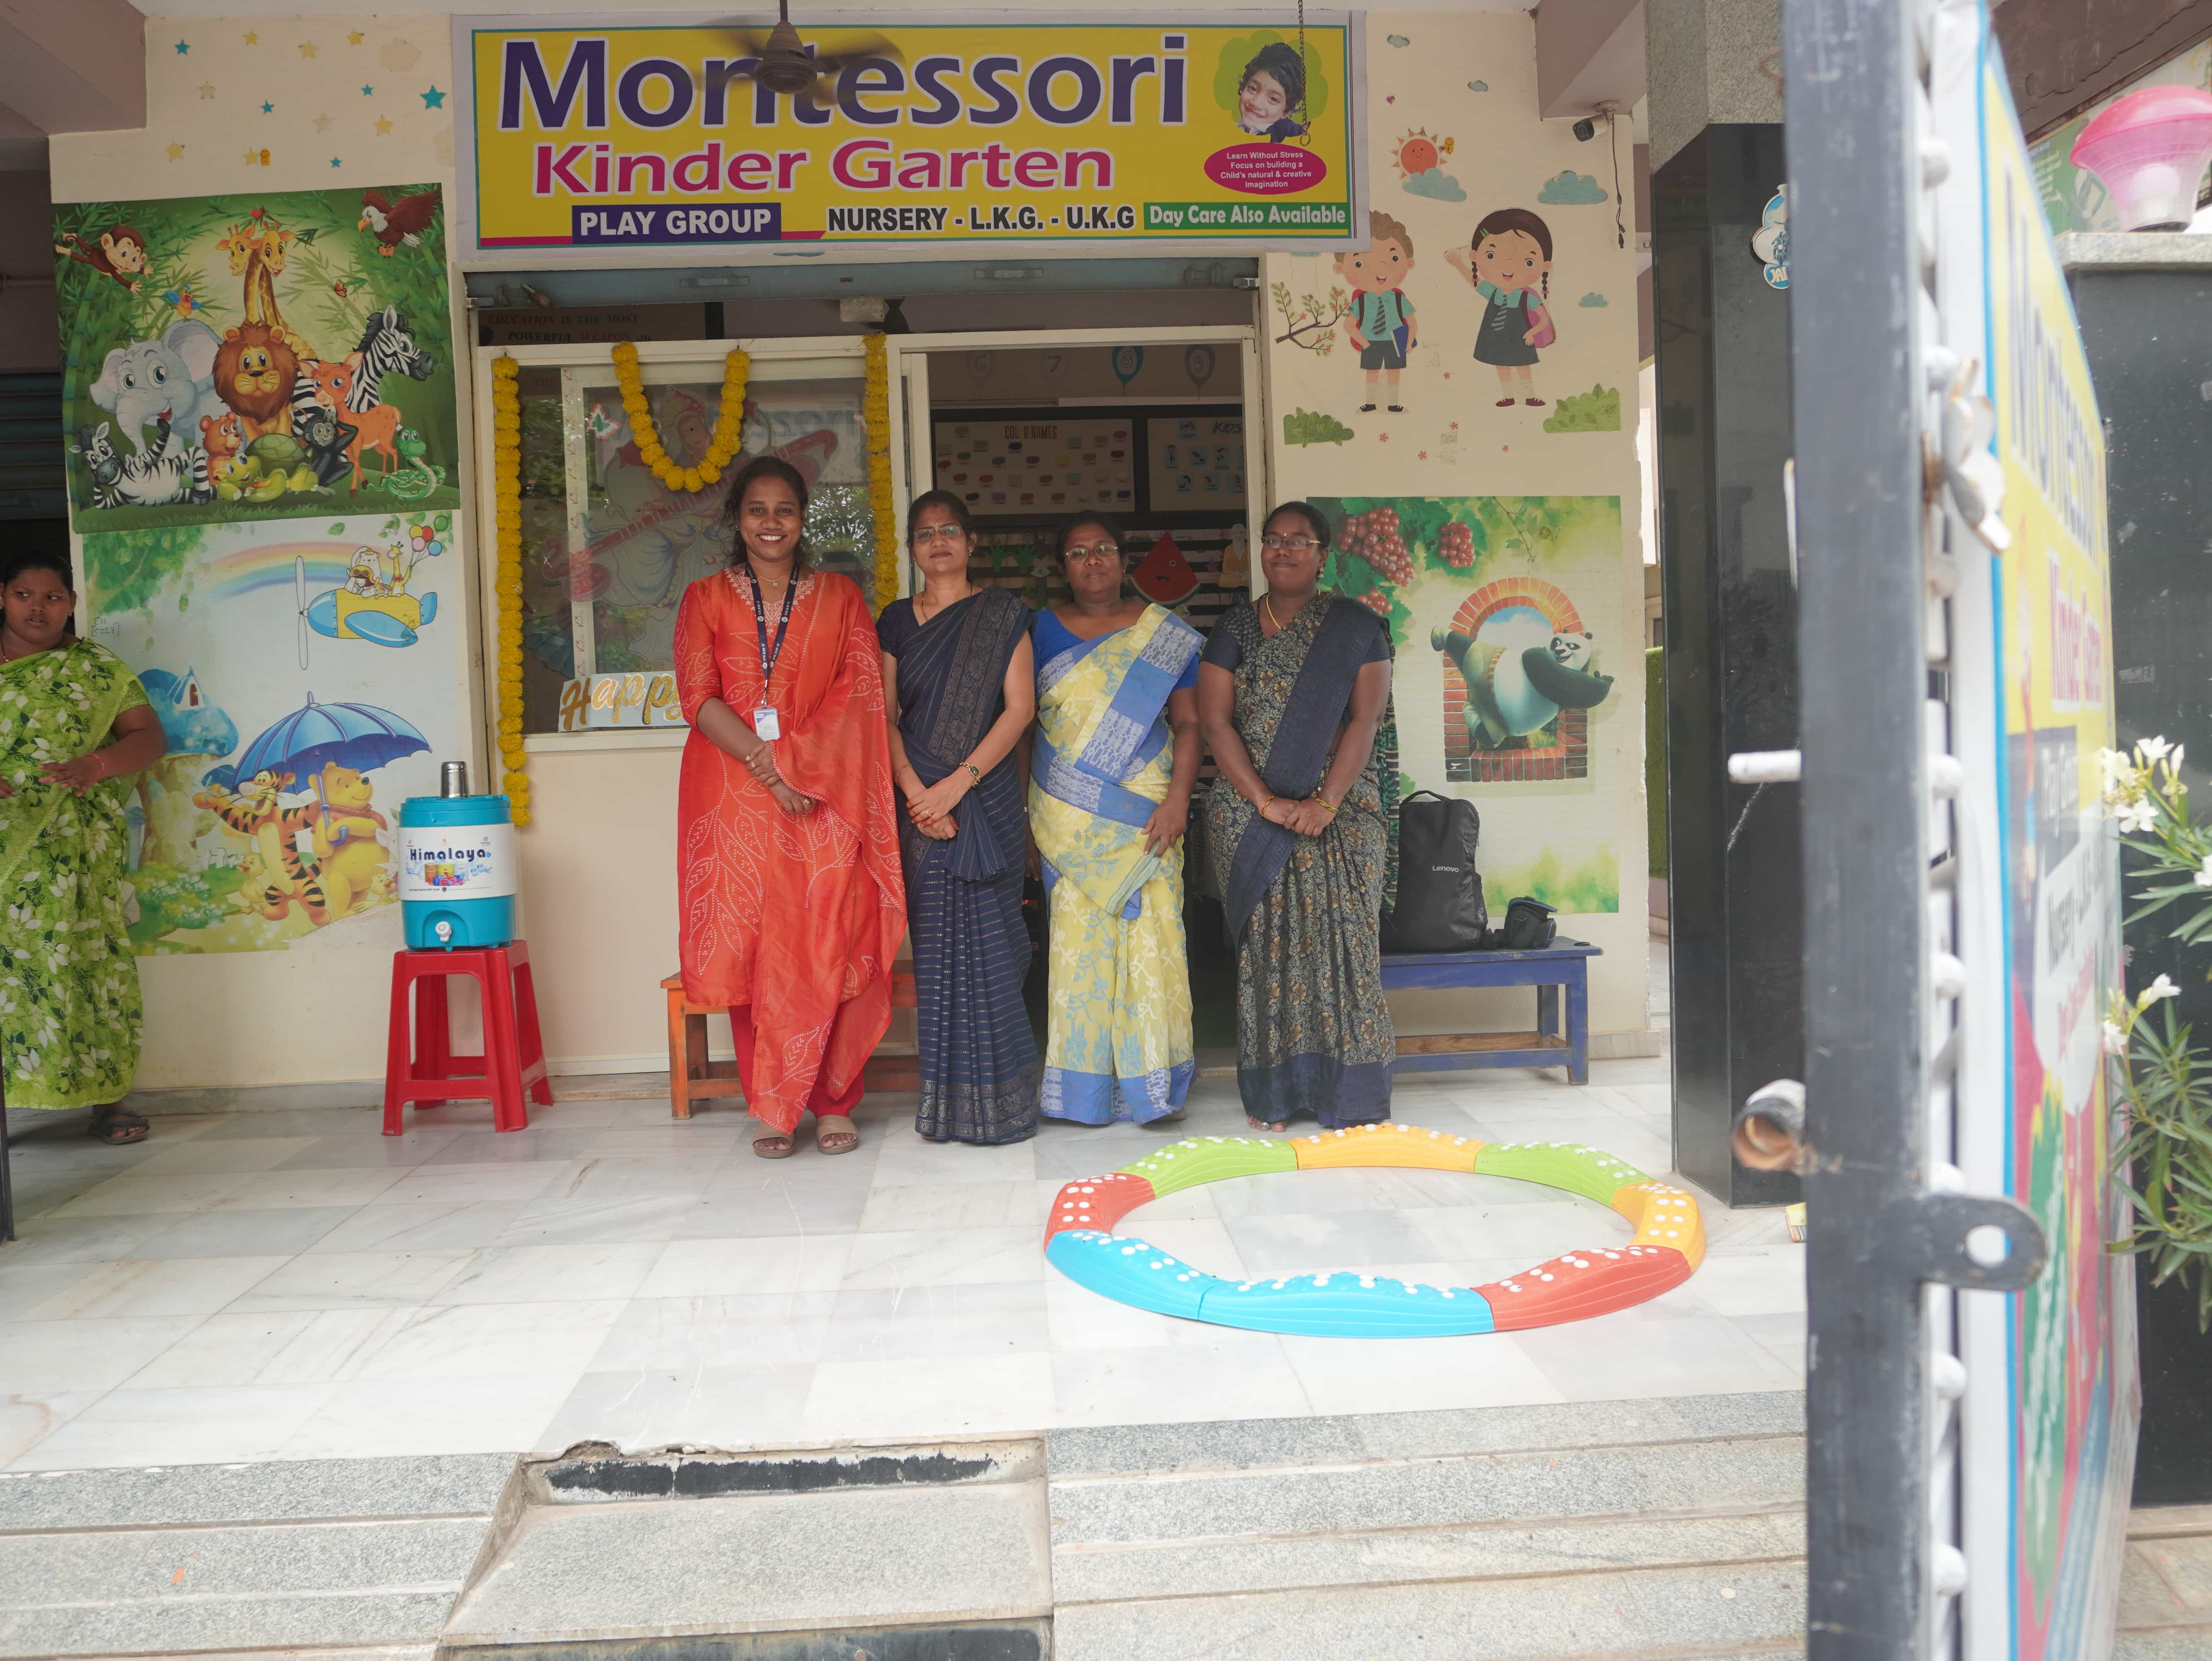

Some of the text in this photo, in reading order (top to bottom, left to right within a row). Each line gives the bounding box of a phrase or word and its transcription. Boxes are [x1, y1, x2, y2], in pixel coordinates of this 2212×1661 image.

[500, 36, 1186, 129] Montessori
[535, 140, 1111, 194] Kinder Garten
[1245, 180, 1288, 189] Imagination
[580, 209, 771, 236] PLAY GROUP
[829, 207, 948, 231] NURSERY
[1067, 206, 1134, 229] U.K.G
[1150, 205, 1346, 227] Day Care Also Available
[488, 314, 640, 325] EDUCATION IS THE MOST
[508, 331, 631, 342] POWERFUL WEAPON
[1047, 356, 1063, 372] 7
[1121, 350, 1133, 368] 8
[1005, 425, 1057, 439] COLR NAMES
[1213, 421, 1242, 434] KIDS
[410, 848, 485, 862] Himalaya
